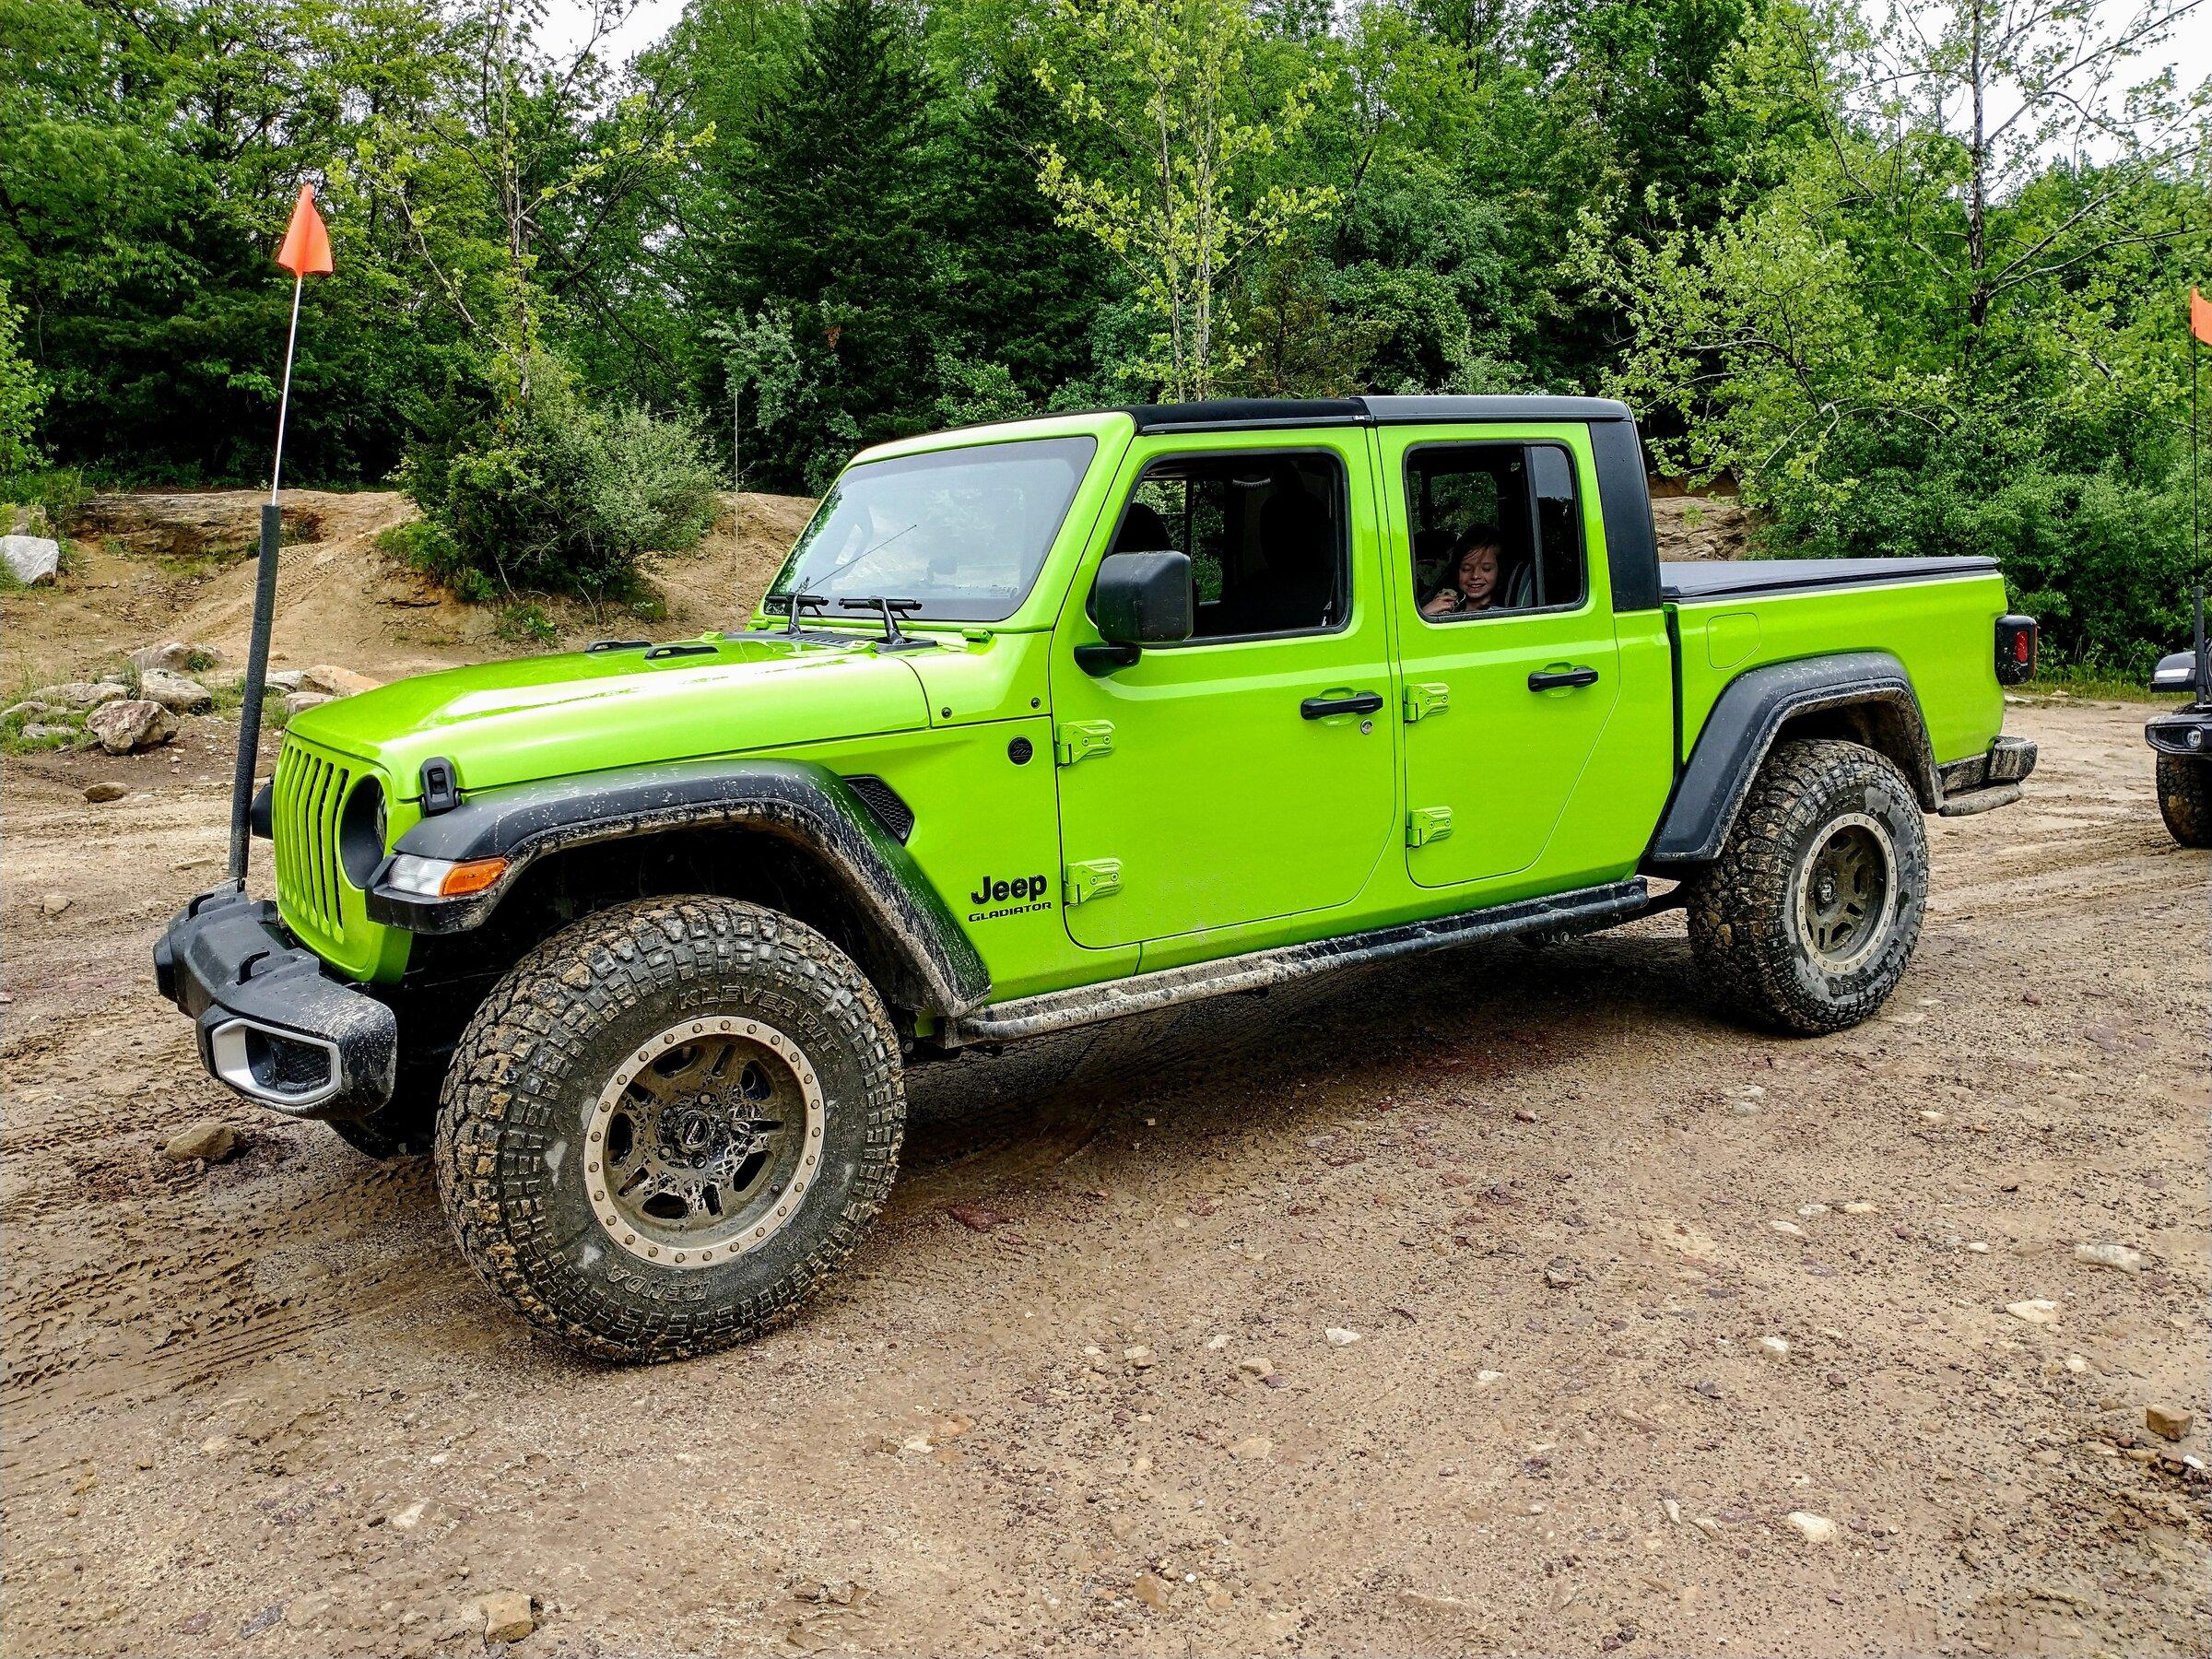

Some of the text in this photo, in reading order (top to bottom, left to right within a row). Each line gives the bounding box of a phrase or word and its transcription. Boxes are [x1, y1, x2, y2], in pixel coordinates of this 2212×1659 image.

[971, 874, 1048, 905] Jeep
[968, 900, 1053, 923] GLADIATOR
[679, 985, 840, 1053] KLEVER R/T
